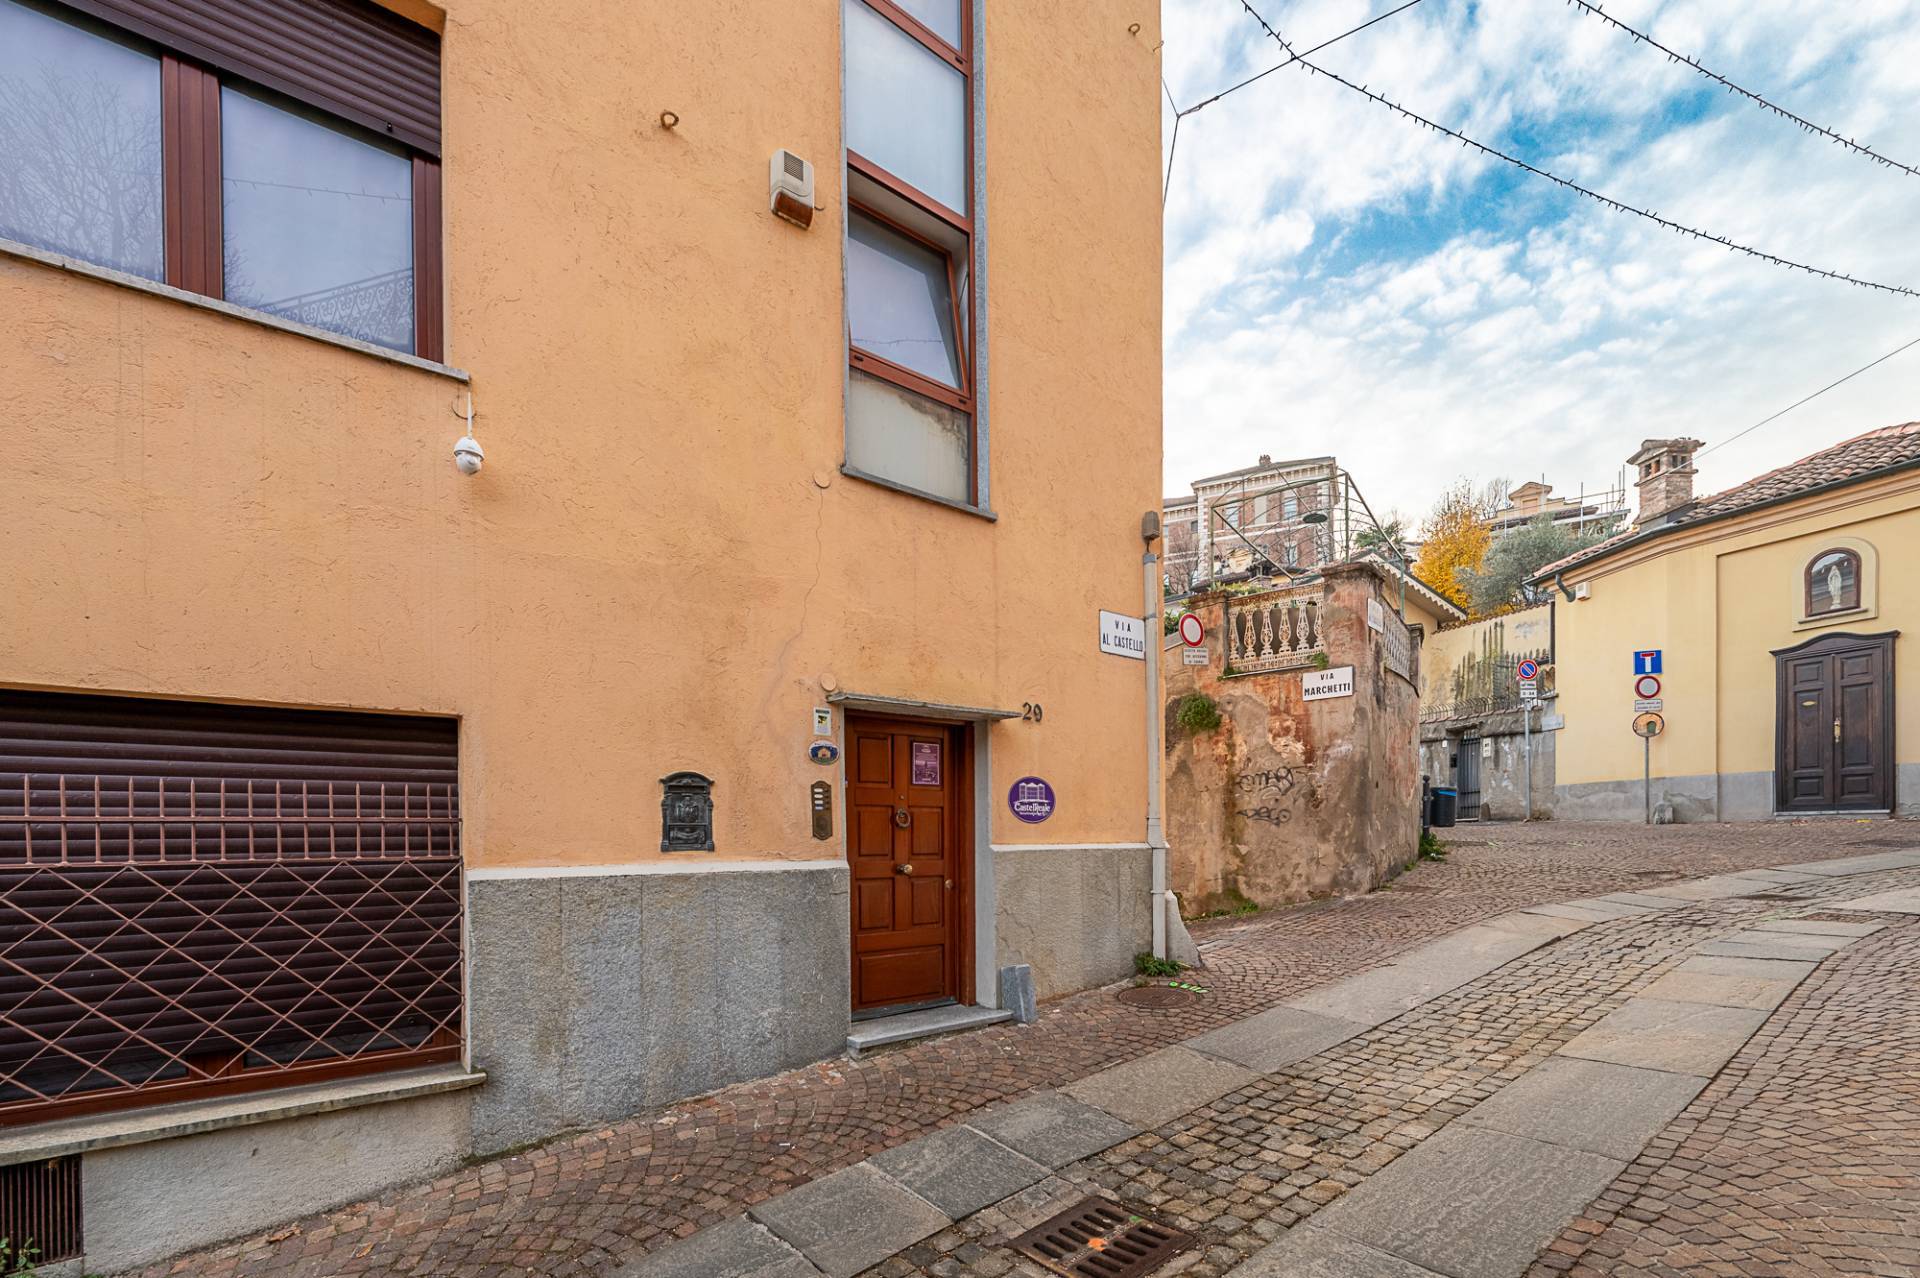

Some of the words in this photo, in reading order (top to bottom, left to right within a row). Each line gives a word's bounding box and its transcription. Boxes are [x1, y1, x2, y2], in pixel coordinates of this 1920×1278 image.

[1115, 620, 1131, 632] VIA
[1103, 633, 1110, 646] AL
[1114, 635, 1143, 652] CASTELLO
[1320, 672, 1334, 681] VIA
[1304, 682, 1351, 697] MARCHETTI
[1022, 702, 1043, 722] 29
